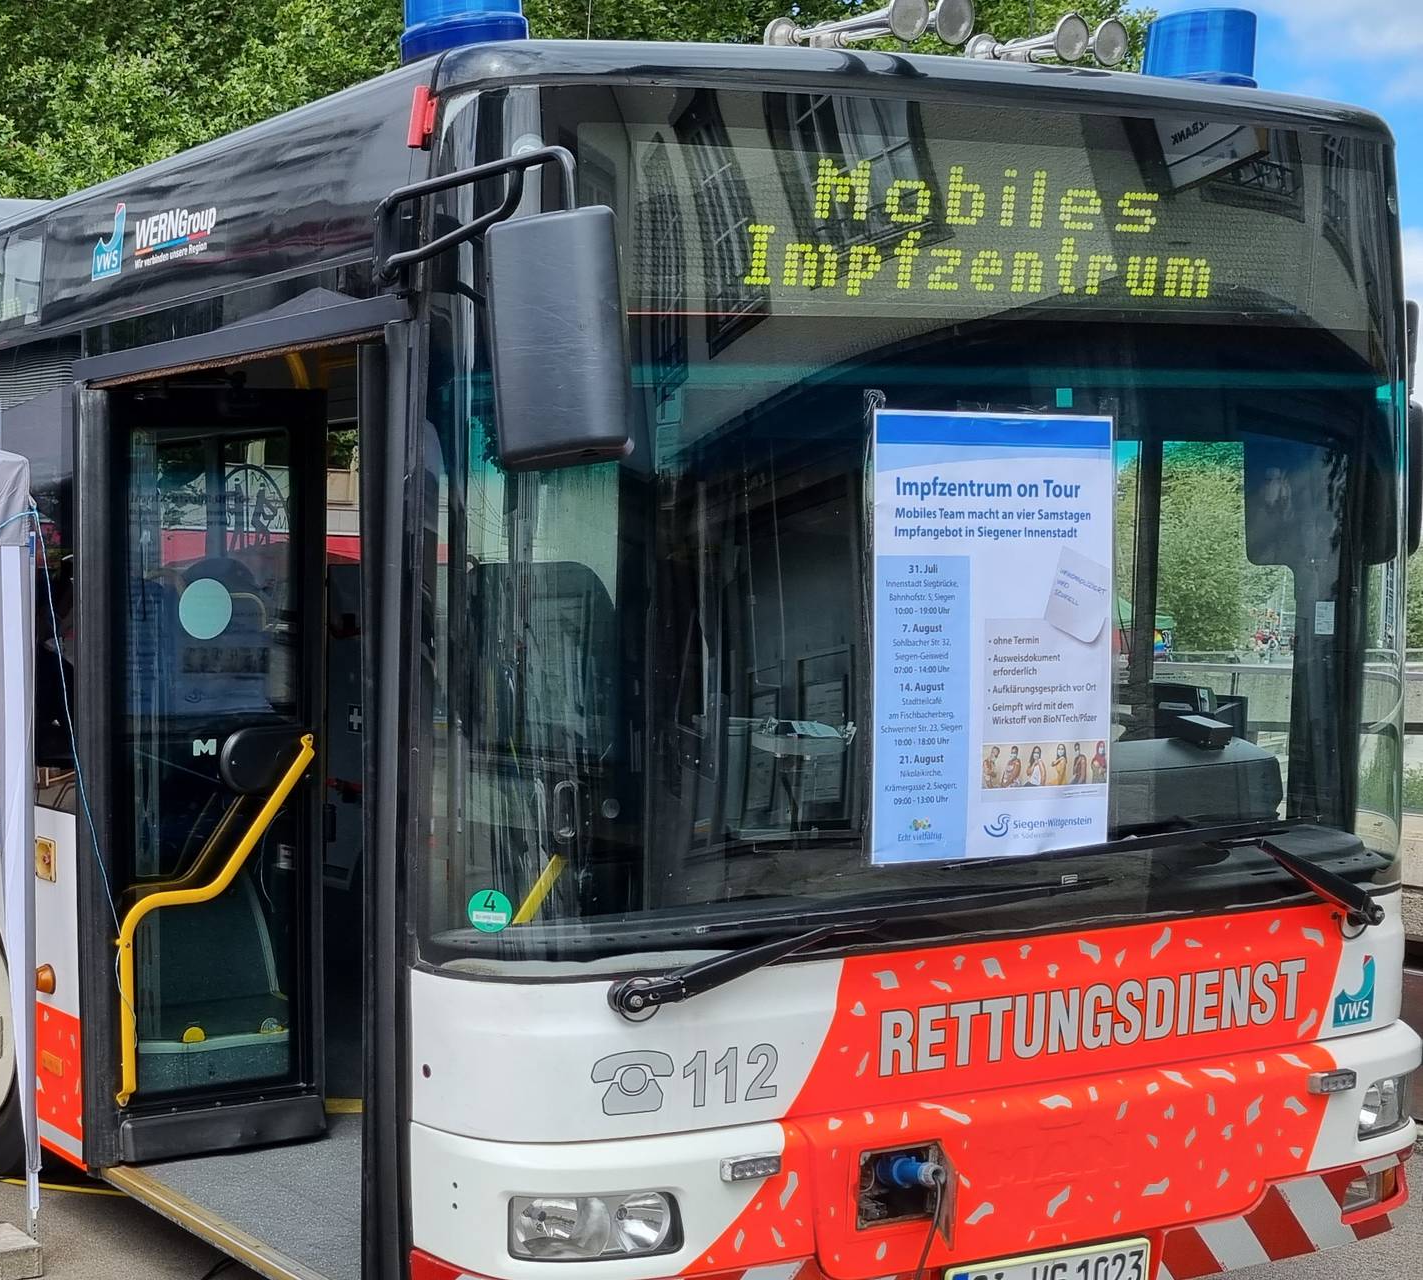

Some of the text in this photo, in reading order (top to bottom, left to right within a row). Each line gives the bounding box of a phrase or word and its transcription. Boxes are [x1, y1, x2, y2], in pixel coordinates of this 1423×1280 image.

[813, 158, 1159, 234] Mobiles
[135, 206, 217, 250] WERNGroup
[96, 249, 119, 273] VWS
[134, 241, 208, 270] Wir verbinden unsere Region
[743, 223, 1212, 298] Impfzentrum
[896, 476, 1081, 501] Impfzentrum on Tour
[895, 507, 1091, 523] Mobiles Team macht an vier Samstagen
[894, 526, 1078, 540] Impfangebot in Siegener Innenstadt
[908, 564, 938, 574] 31. Juli
[894, 607, 914, 615] 10:00
[919, 606, 938, 615] 19:00
[938, 606, 951, 615] Uhr
[902, 624, 943, 635] 7. August
[993, 636, 1040, 645] ohne Termin
[993, 653, 1061, 662] Ausweisdokument
[918, 666, 937, 674] 14:00
[937, 665, 951, 674] Uhr
[993, 667, 1037, 676] erforderlich
[899, 683, 945, 694] 14. August
[992, 684, 1071, 695] Aufklärungsgespräch
[1085, 682, 1097, 692] Ort
[992, 701, 1074, 713] Geimpft wird mit dem
[992, 715, 1026, 725] Wirkstoff
[894, 739, 912, 747] 10:00
[918, 738, 936, 747] 18:00
[937, 737, 950, 746] Uhr
[899, 755, 944, 767] 21. August
[893, 798, 912, 806] 09:00
[917, 797, 935, 805] 13:00
[936, 796, 949, 804] Uhr
[483, 891, 496, 912] 4
[1338, 1000, 1370, 1022] VWS
[878, 958, 1306, 1077] RETTUNGSDIENST
[682, 1043, 779, 1108] 112
